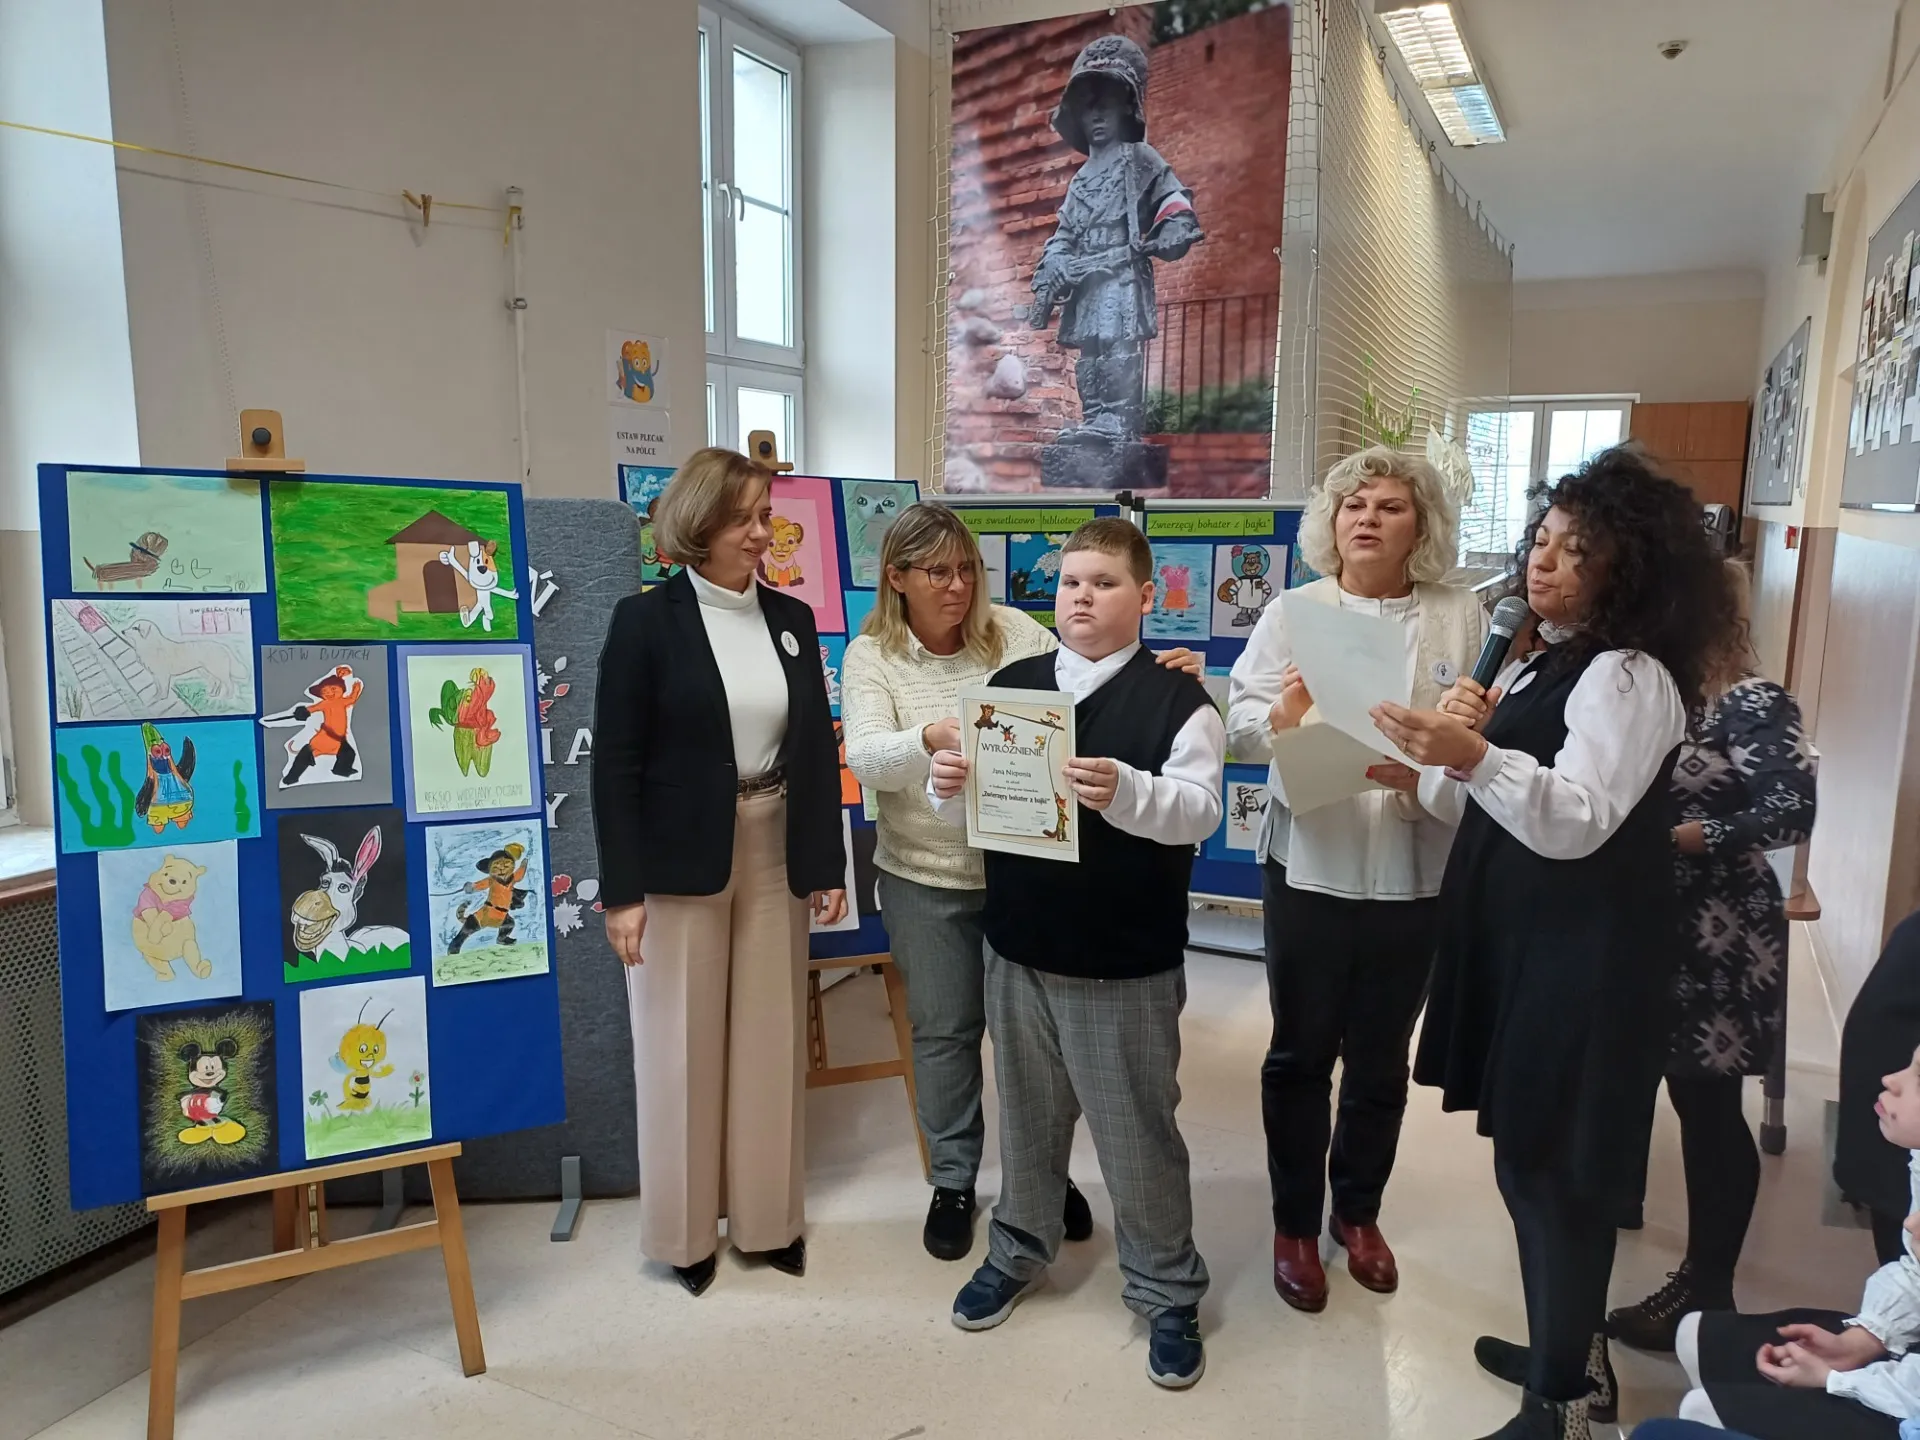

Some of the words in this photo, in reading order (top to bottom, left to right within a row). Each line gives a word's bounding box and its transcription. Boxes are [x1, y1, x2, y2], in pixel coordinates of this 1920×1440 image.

[617, 431, 638, 441] USTAW
[640, 433, 664, 443] PLECAK
[626, 446, 635, 454] NA
[963, 516, 982, 525] kurs
[1042, 514, 1089, 526] biblioteczn
[300, 647, 309, 660] W
[319, 647, 371, 661] BUTACH
